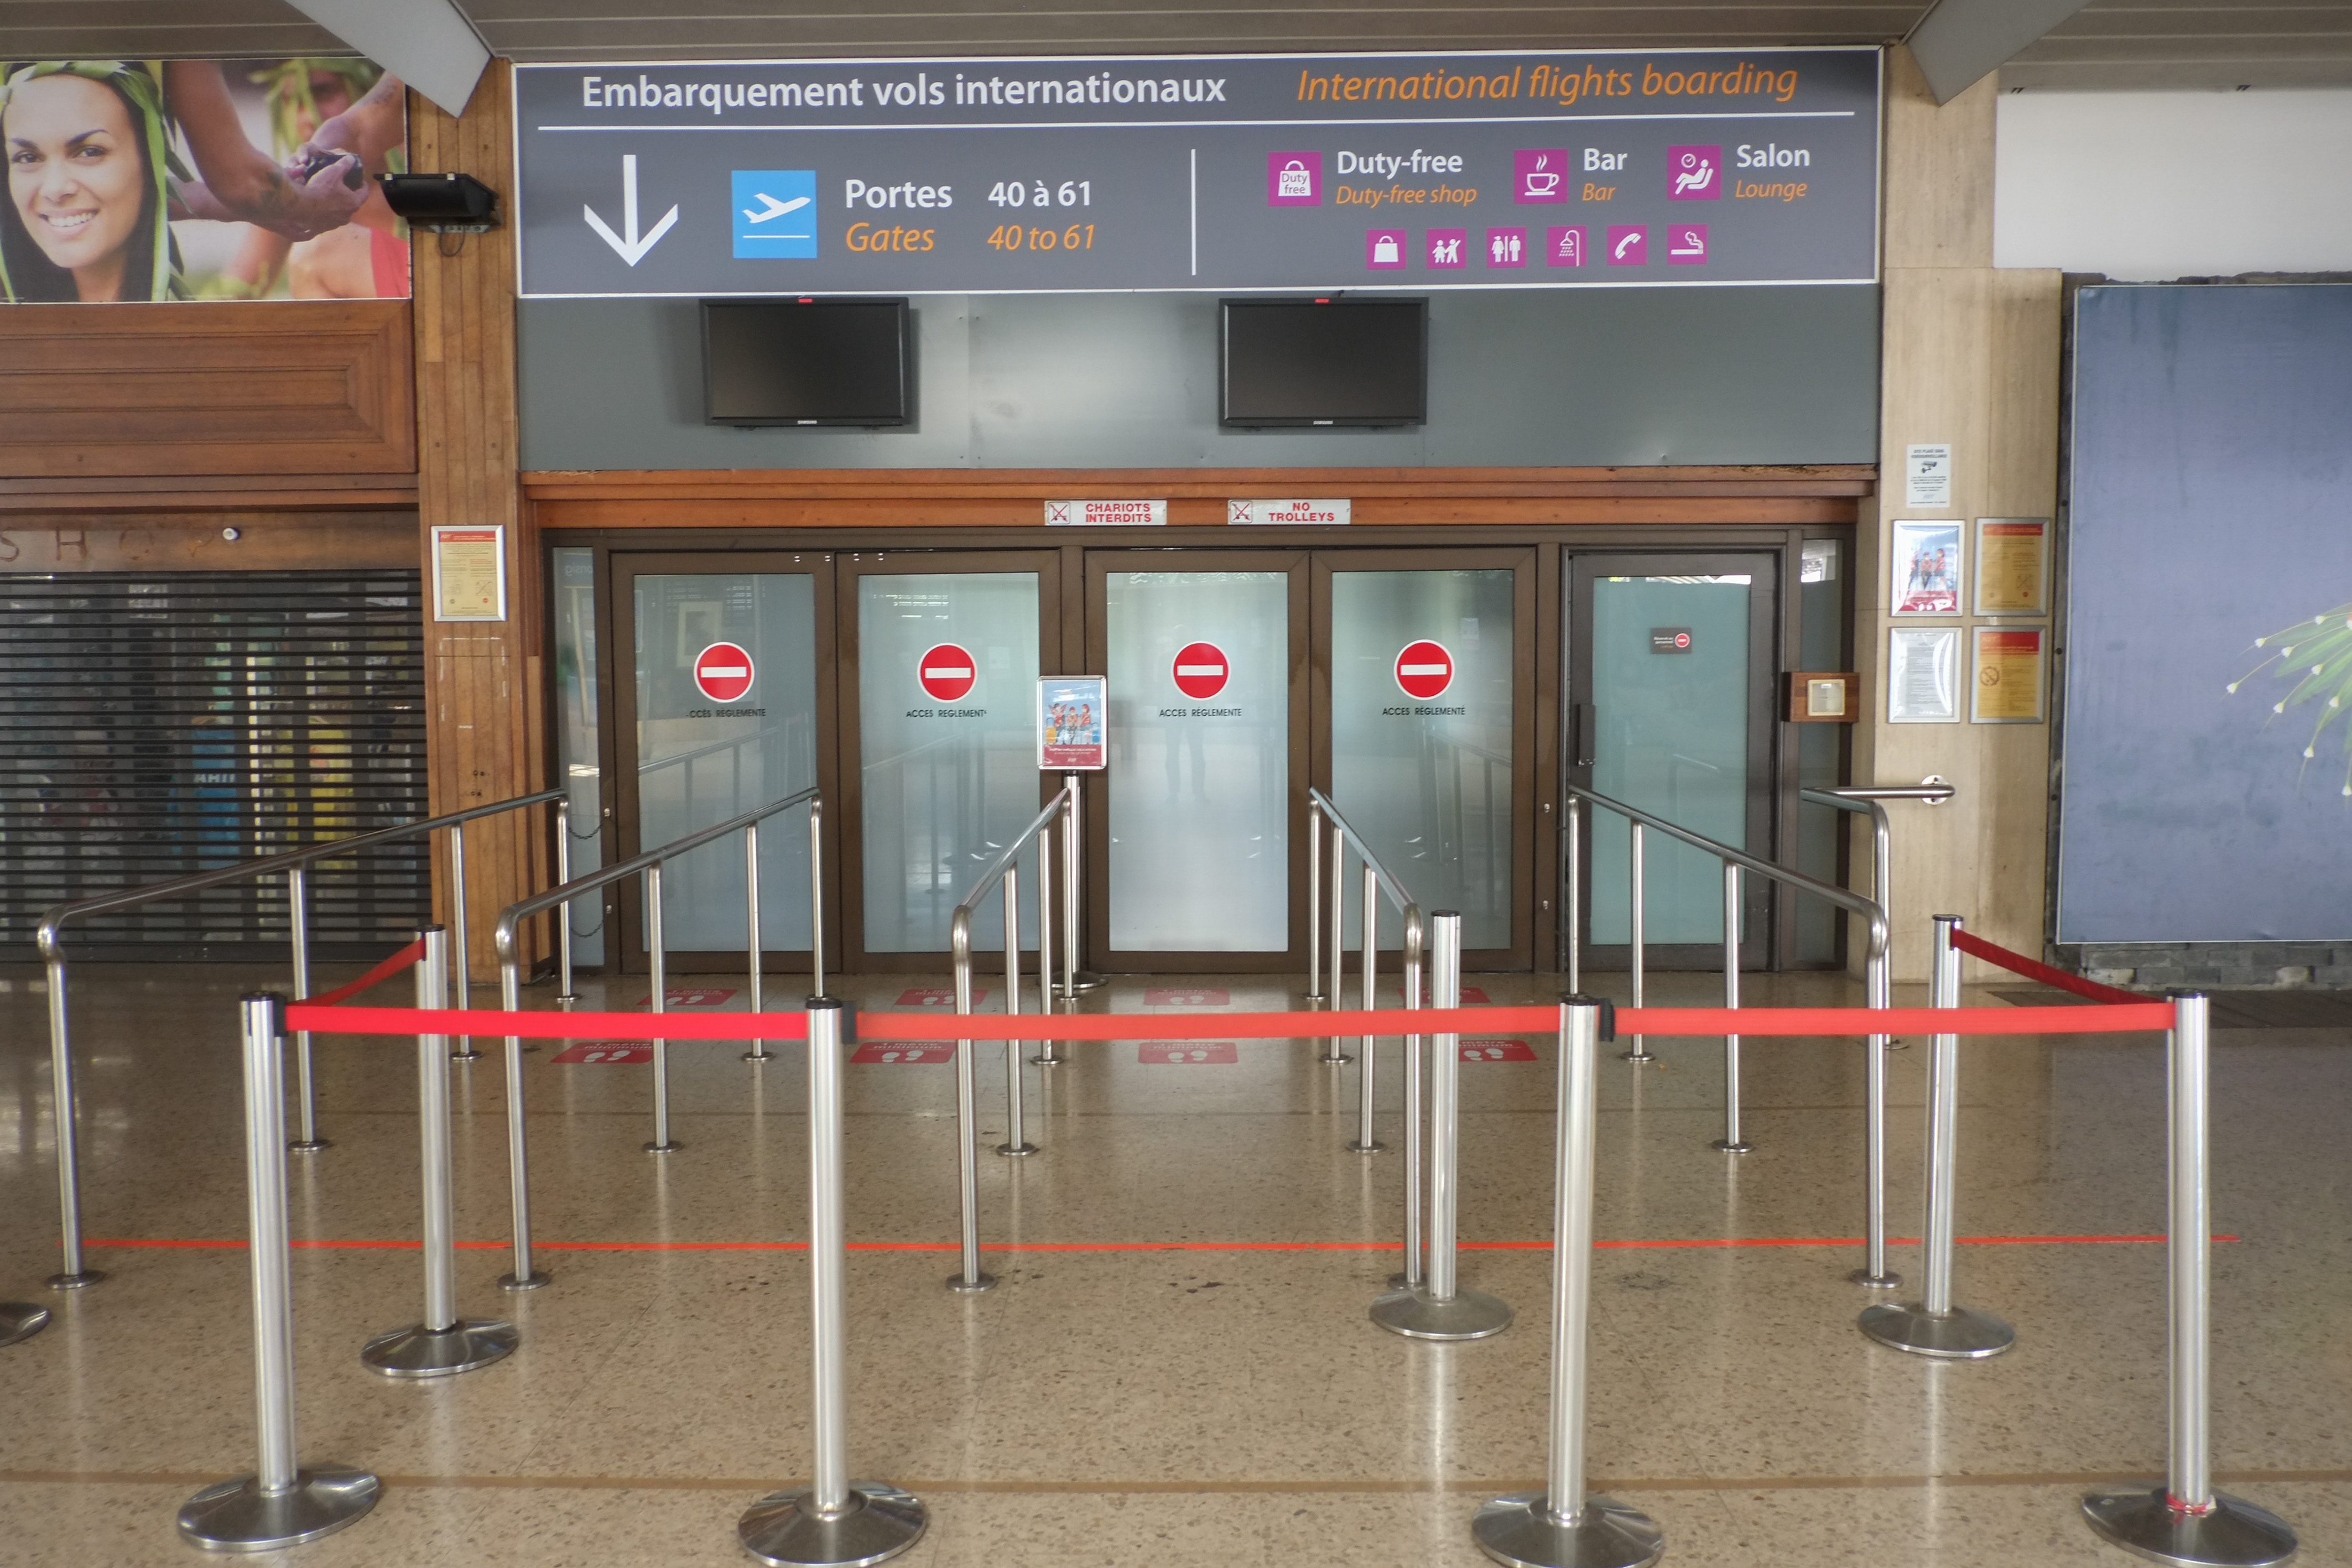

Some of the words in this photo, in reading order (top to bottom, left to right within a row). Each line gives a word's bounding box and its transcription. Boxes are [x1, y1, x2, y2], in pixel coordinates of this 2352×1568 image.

[582, 76, 863, 114] Embarquement
[873, 73, 945, 105] vols
[956, 72, 1226, 104] internationaux
[1298, 65, 1522, 101] International
[1528, 64, 1633, 106] flights
[1641, 61, 1799, 103] boarding
[1337, 149, 1463, 179] Duty-free
[1584, 148, 1627, 171] Bar
[1736, 143, 1810, 168] Salon
[1281, 173, 1308, 185] Duty
[1284, 184, 1305, 194] free
[846, 179, 953, 208] Portes
[988, 181, 1026, 207] 40
[1033, 180, 1049, 207] à
[1058, 180, 1090, 207] 61
[1336, 184, 1427, 209] Duty-free
[1430, 184, 1478, 207] shop
[1581, 182, 1616, 202] Bar
[1735, 179, 1808, 203] Lounge
[846, 222, 935, 252] Gates
[987, 225, 1023, 251] 40
[1029, 227, 1058, 251] to
[1063, 224, 1095, 250] 61
[1086, 503, 1151, 512] CHARIOTS
[1086, 513, 1152, 523] INTERDITS
[1269, 512, 1335, 522] TROLLEYS
[1293, 502, 1311, 512] NO
